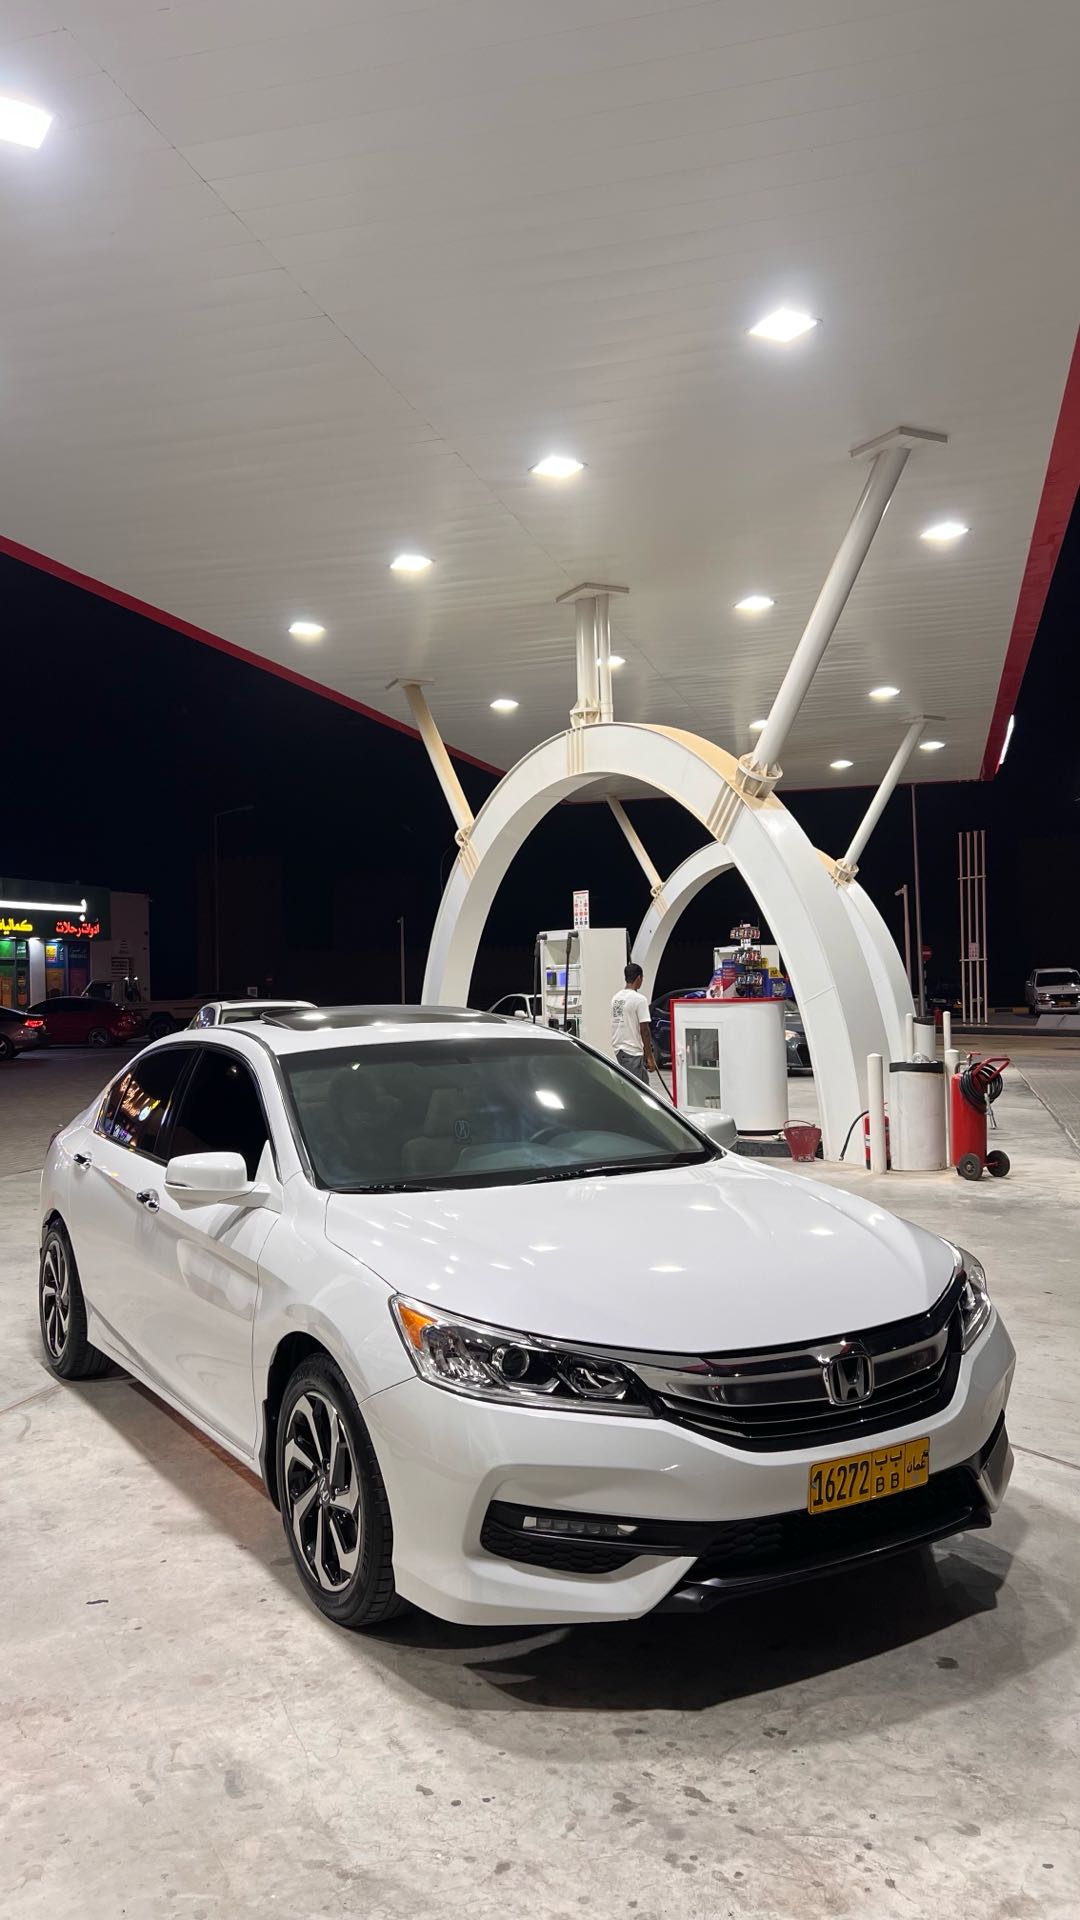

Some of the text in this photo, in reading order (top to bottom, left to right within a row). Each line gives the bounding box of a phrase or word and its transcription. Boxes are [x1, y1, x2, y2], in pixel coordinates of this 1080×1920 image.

[813, 1460, 870, 1506] 16272
[876, 1472, 899, 1493] B B
